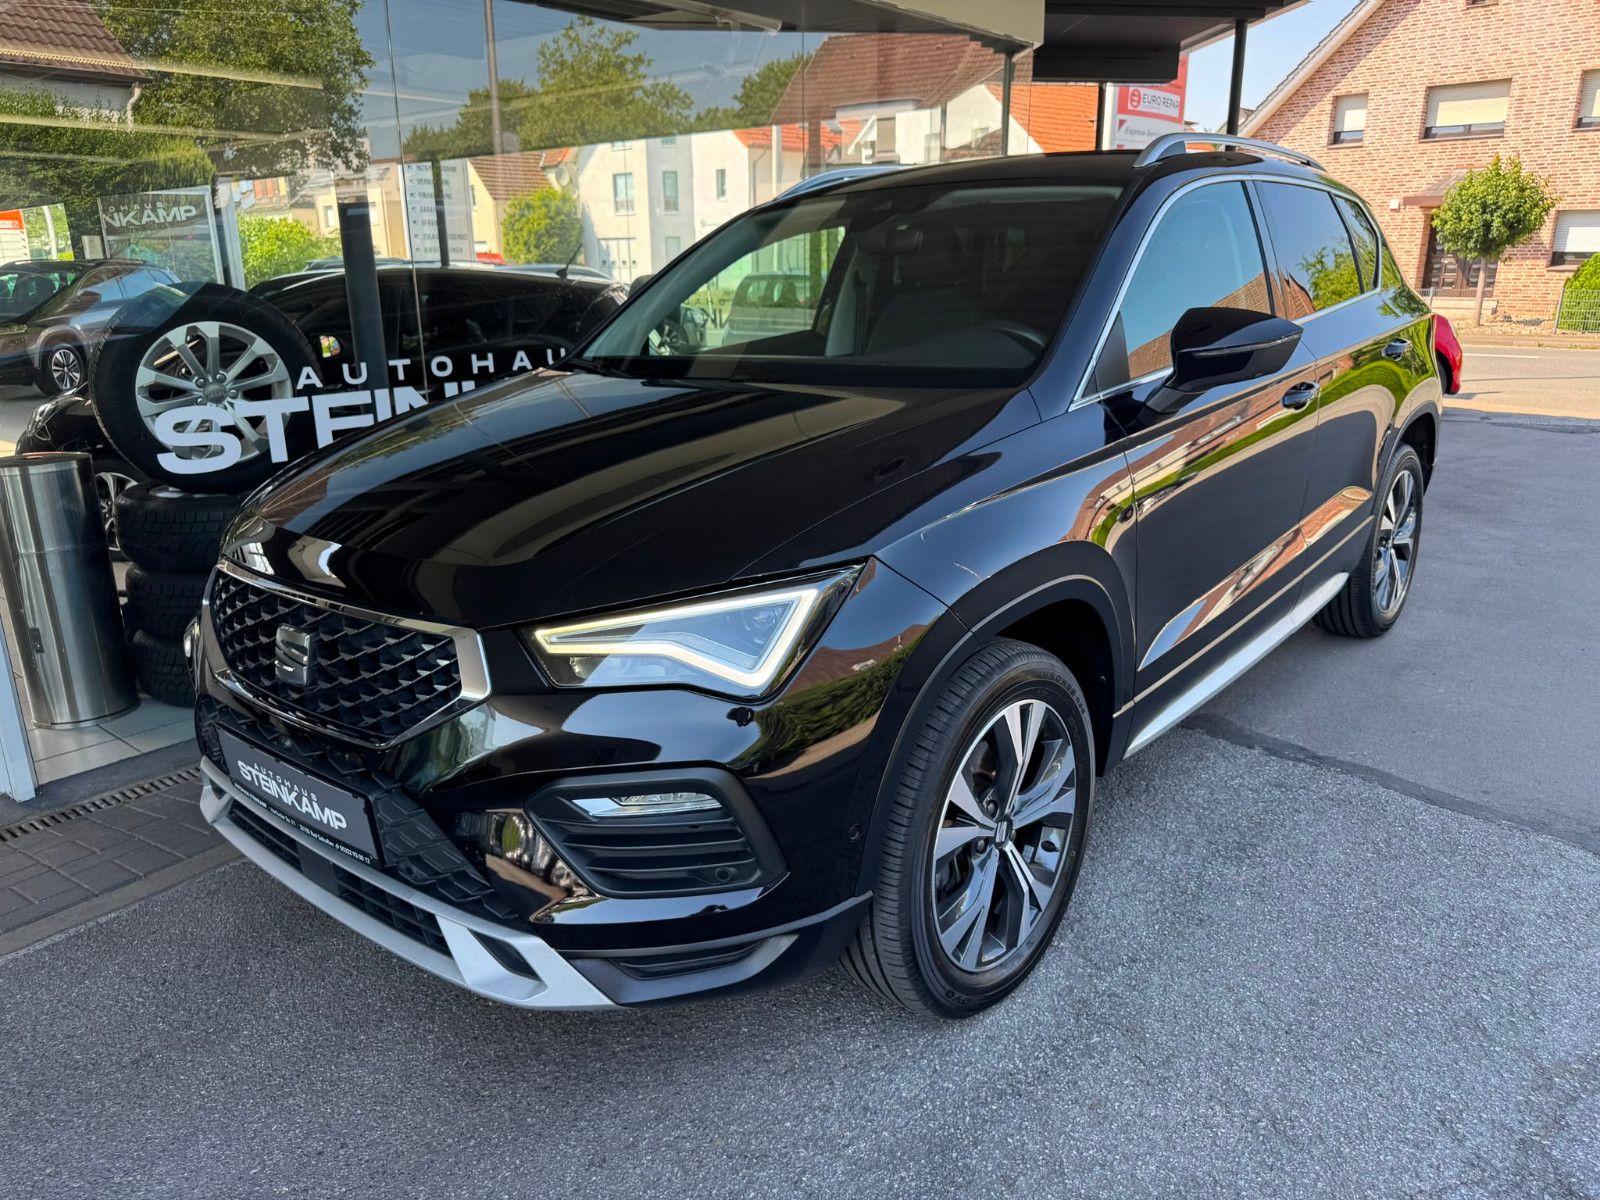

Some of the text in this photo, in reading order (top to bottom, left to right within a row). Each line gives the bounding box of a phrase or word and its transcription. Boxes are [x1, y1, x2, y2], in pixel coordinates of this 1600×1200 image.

[1142, 94, 1161, 106] EURO
[237, 760, 347, 830] STEINKAMP
[254, 763, 318, 801] AUTOHAUS
